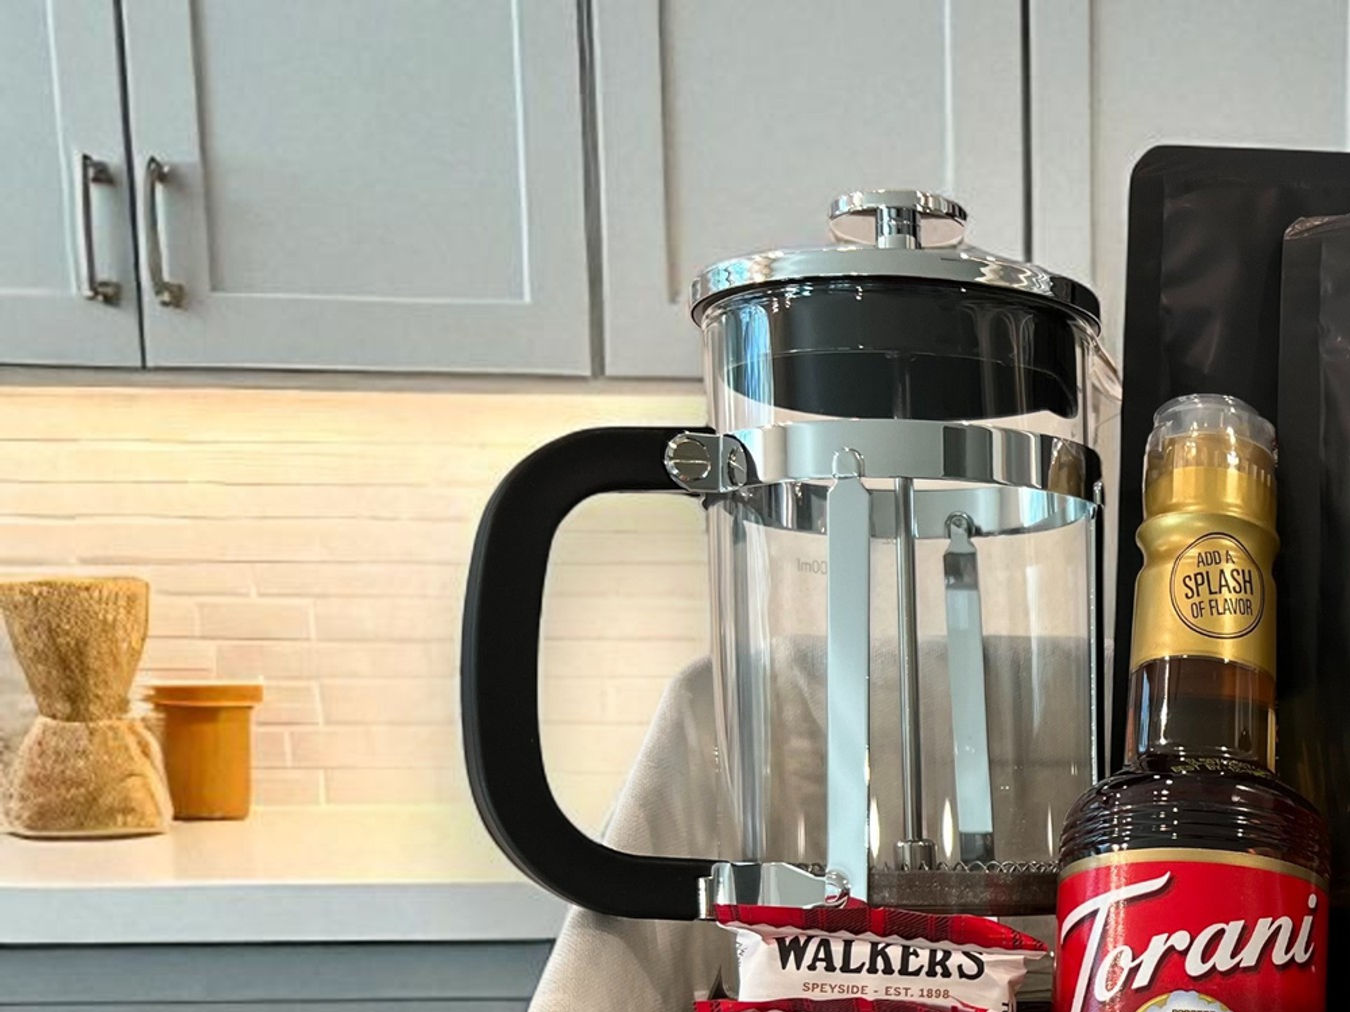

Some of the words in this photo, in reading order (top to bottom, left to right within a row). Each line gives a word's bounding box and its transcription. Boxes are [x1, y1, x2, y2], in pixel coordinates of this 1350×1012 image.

[1196, 550, 1222, 568] ADD
[1225, 549, 1236, 565] A
[1182, 568, 1254, 600] SPLASH
[1190, 600, 1206, 619] OF
[1208, 599, 1253, 617] FLAVOR
[774, 935, 985, 980] WALKERS
[802, 982, 869, 996] SPEYSIDE
[884, 986, 914, 998] EST.
[919, 988, 950, 999] 1898
